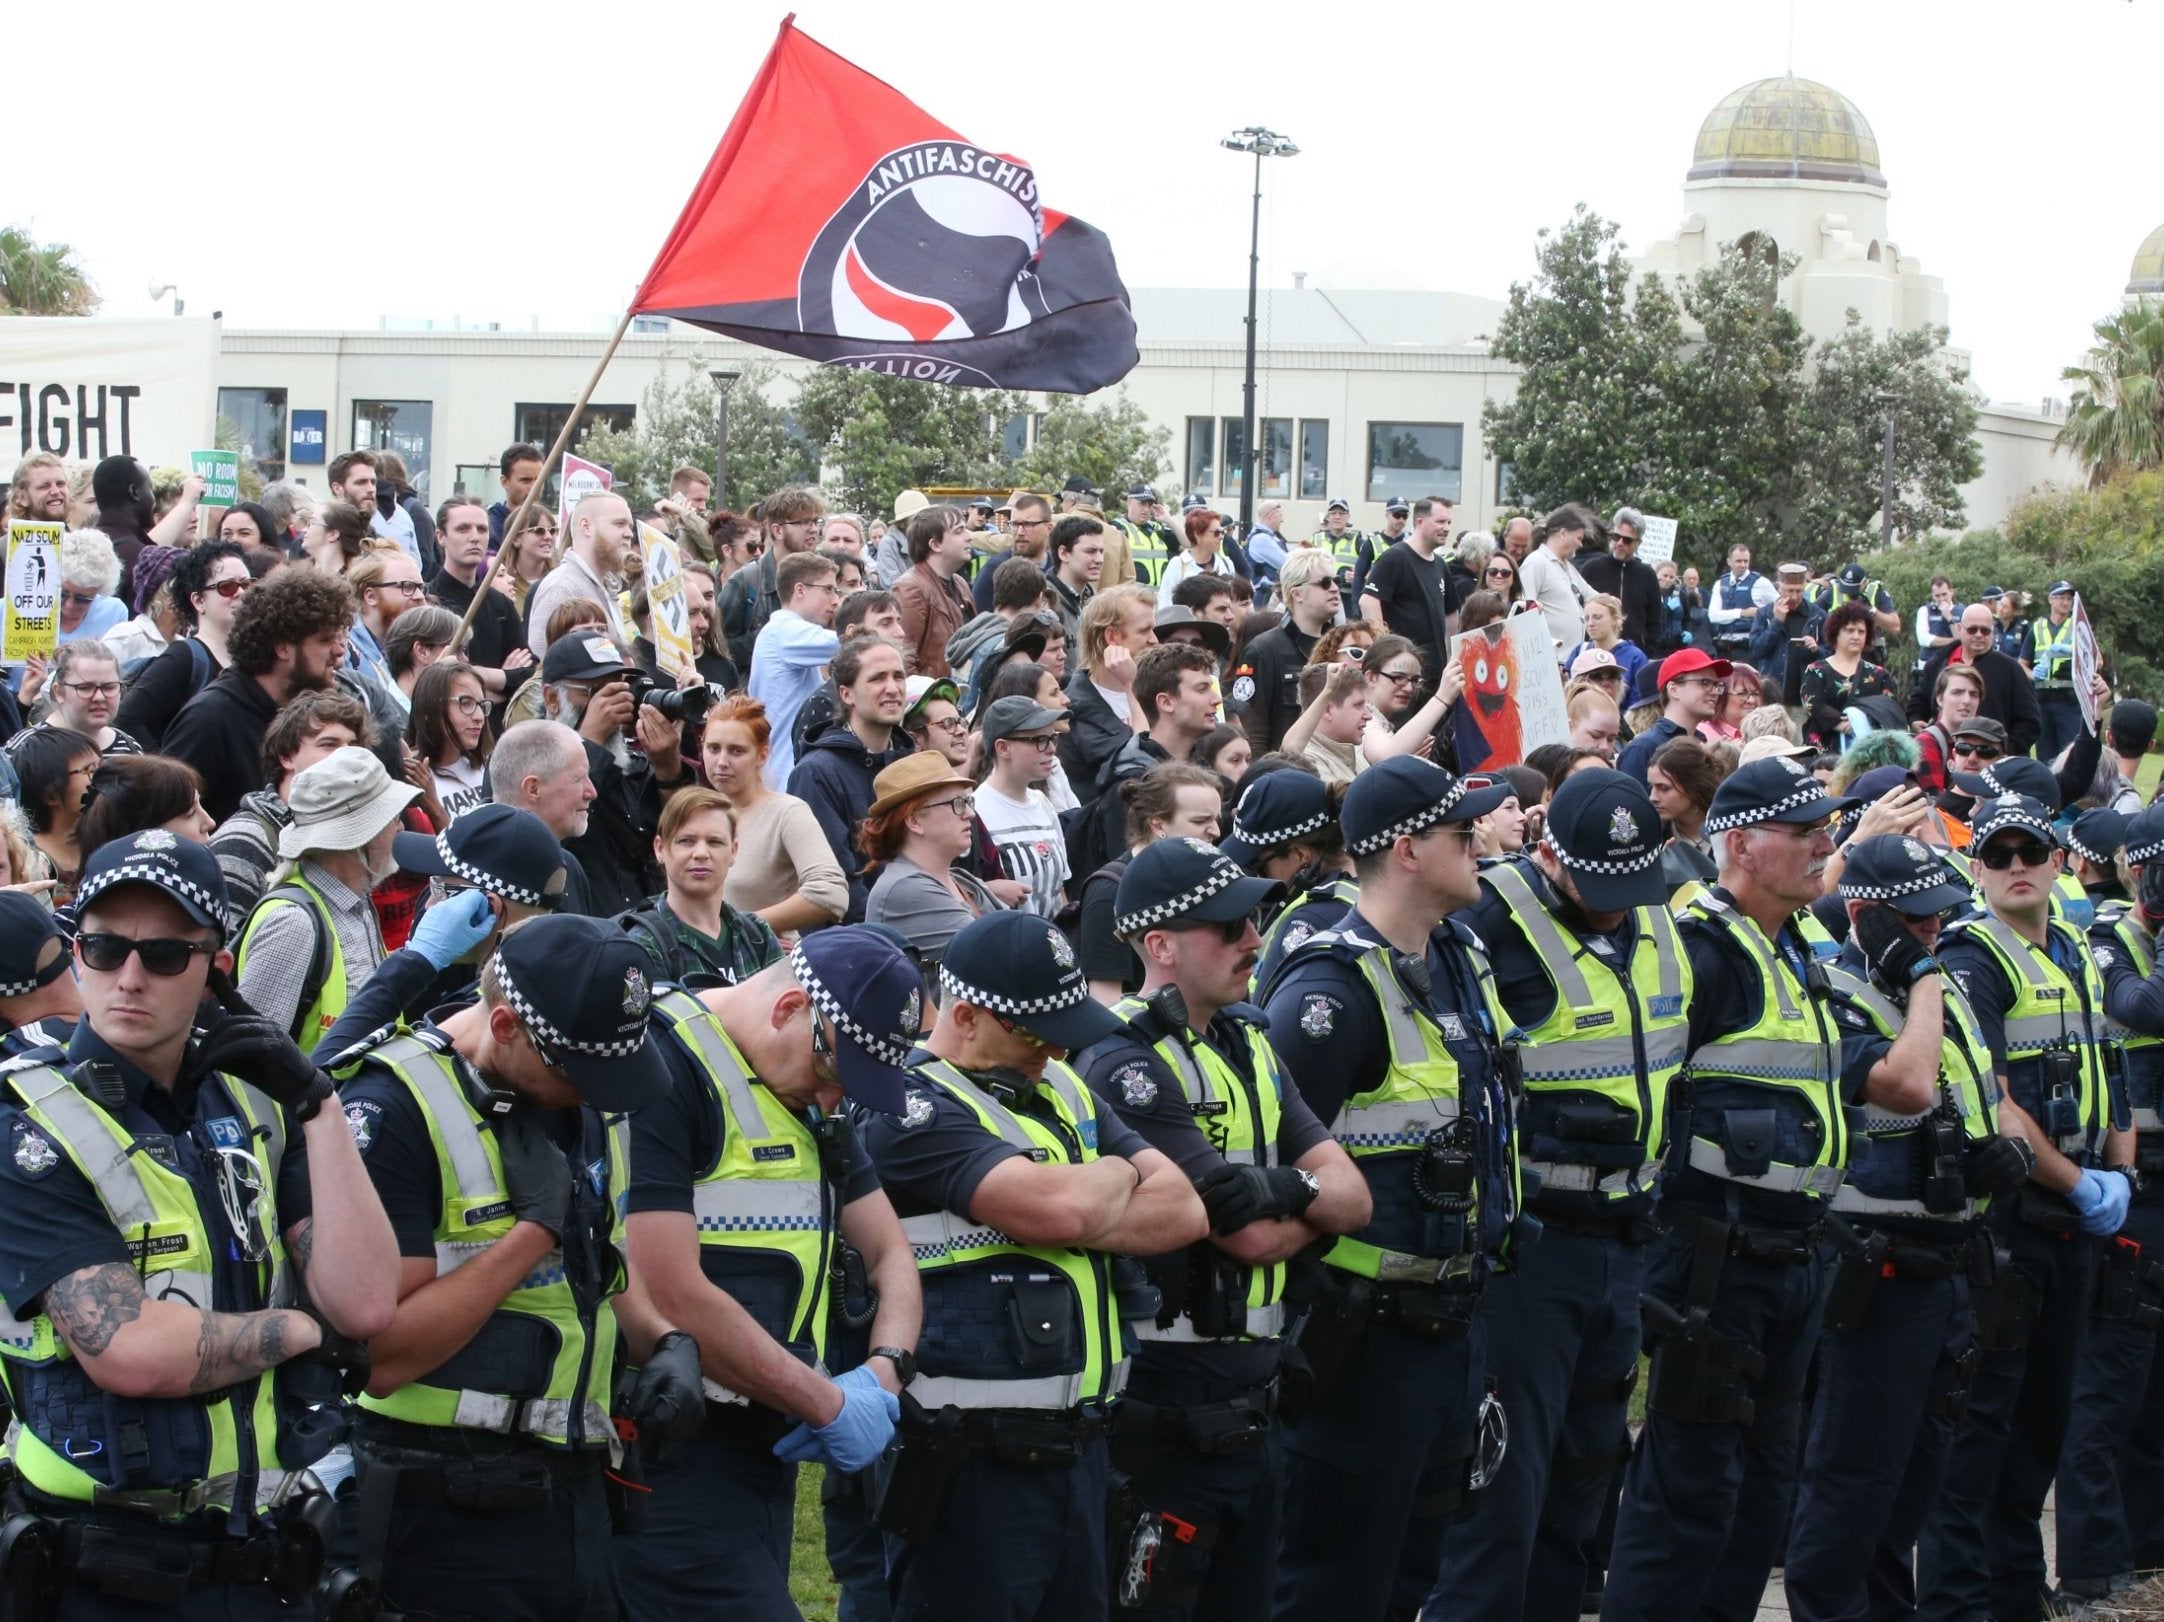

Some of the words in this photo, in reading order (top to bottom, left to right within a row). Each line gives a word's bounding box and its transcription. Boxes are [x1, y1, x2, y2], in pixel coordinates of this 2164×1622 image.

[197, 461, 213, 479] NO
[215, 462, 238, 481] ROOM
[203, 482, 213, 498] OR
[12, 530, 34, 543] NAZI
[36, 531, 60, 544] SCUM
[14, 595, 34, 608] OFF
[36, 595, 54, 608] OUR
[14, 617, 52, 631] STREETS
[1525, 691, 1549, 715] PISS
[1527, 716, 1549, 746] OFF
[124, 851, 155, 862] VICTORIA
[156, 852, 179, 868] POLICE
[343, 1101, 362, 1111] CTORIA
[362, 1101, 382, 1114] POLICE
[127, 1240, 158, 1251] Waren
[161, 1235, 184, 1247] Frost
[133, 1248, 152, 1257] Actg
[153, 1245, 180, 1255] Sergeant
